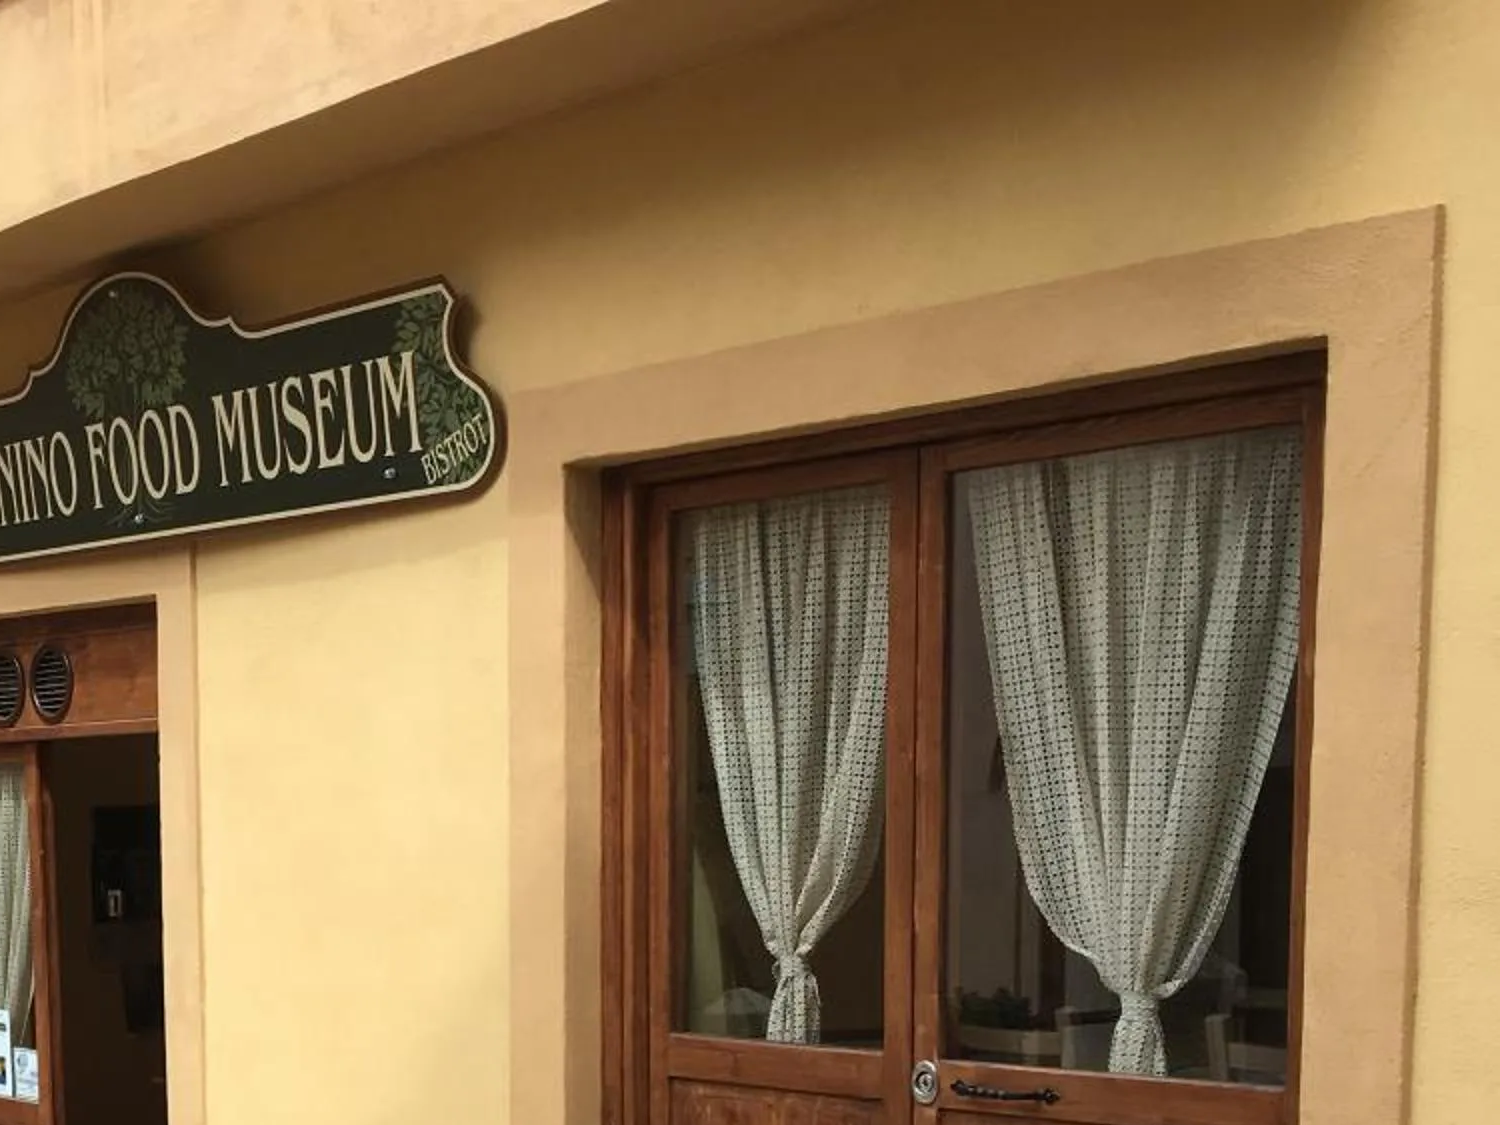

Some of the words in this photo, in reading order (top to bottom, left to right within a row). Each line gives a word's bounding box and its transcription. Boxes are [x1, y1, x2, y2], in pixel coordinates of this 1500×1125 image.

[86, 405, 199, 510] FOOD
[212, 351, 424, 488] MUSEUM
[421, 414, 489, 485] BISTROT
